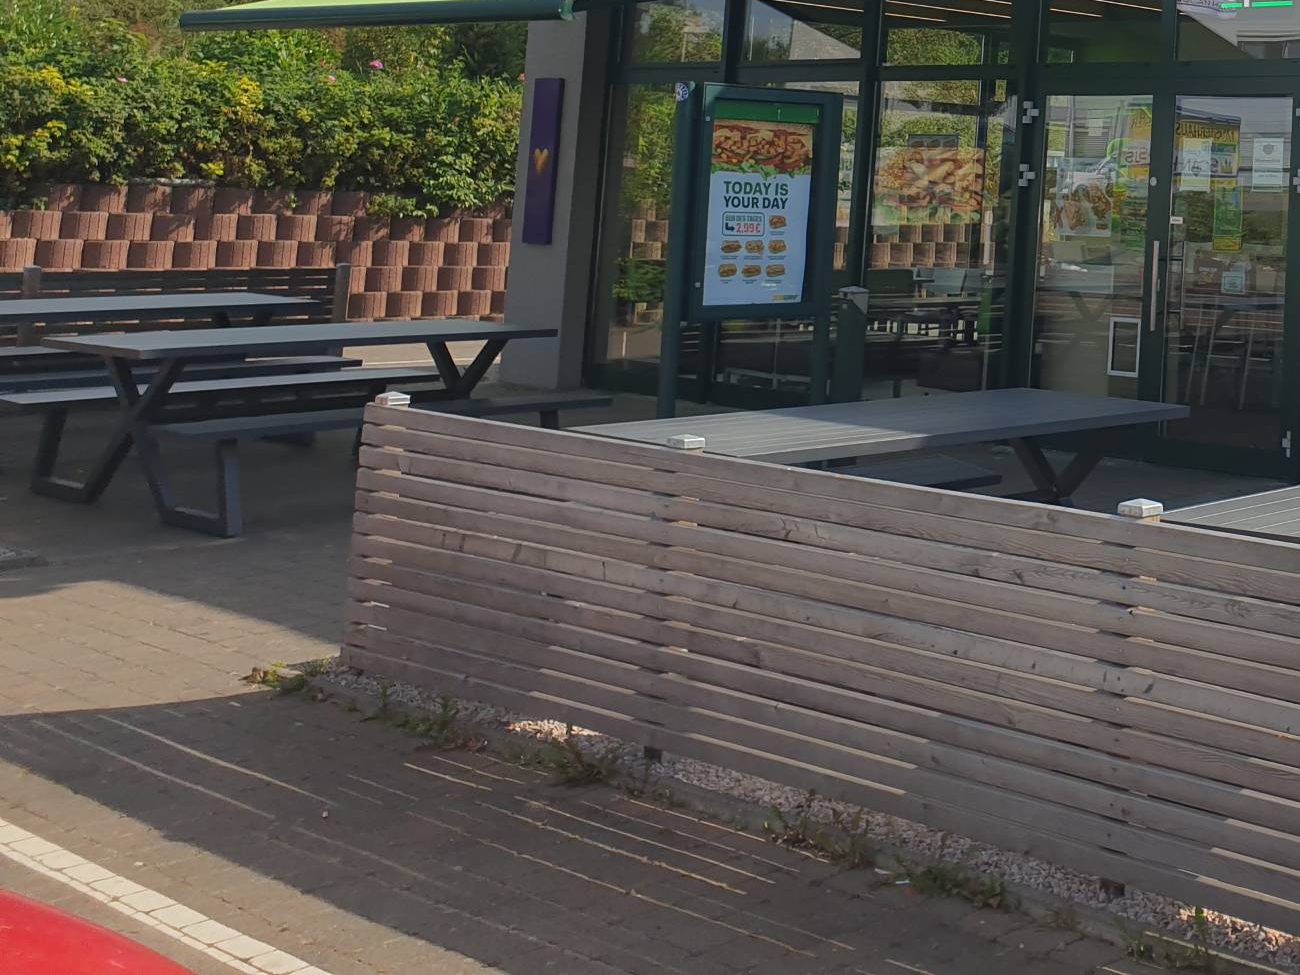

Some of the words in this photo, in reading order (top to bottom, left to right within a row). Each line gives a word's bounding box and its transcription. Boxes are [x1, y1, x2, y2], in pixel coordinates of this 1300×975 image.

[723, 180, 771, 196] TODAY
[775, 183, 789, 196] IS
[724, 195, 759, 209] YOUR
[762, 197, 788, 210] DAY
